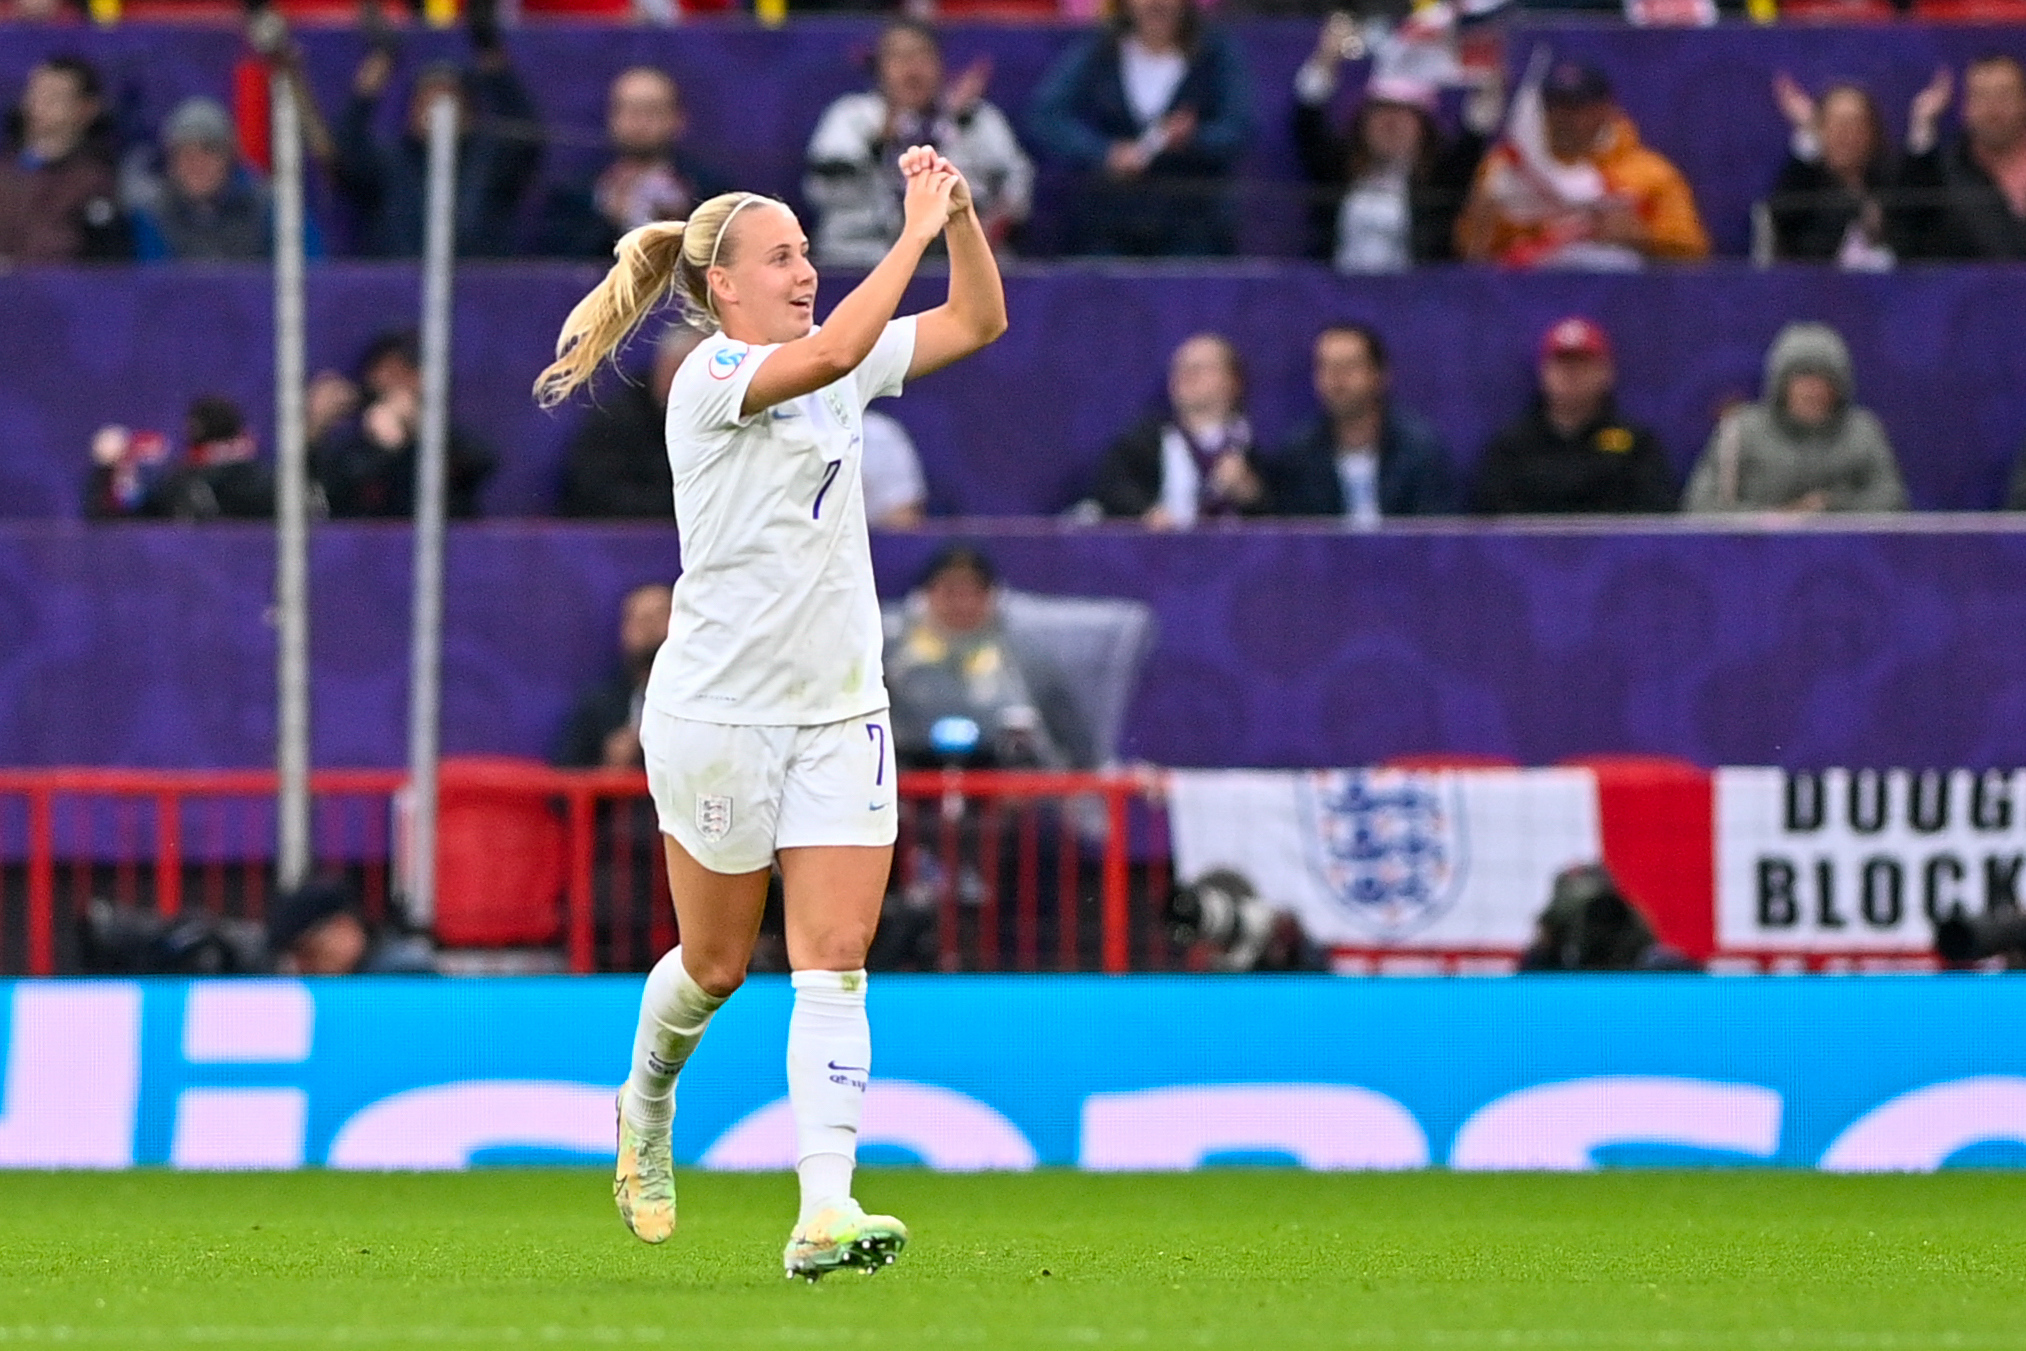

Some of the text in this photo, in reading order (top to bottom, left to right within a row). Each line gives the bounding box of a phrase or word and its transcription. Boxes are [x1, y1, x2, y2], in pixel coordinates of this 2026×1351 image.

[813, 459, 842, 520] 7
[866, 724, 884, 786] 7
[1784, 766, 2013, 833] DOUG
[1758, 855, 2024, 928] BLOCK
